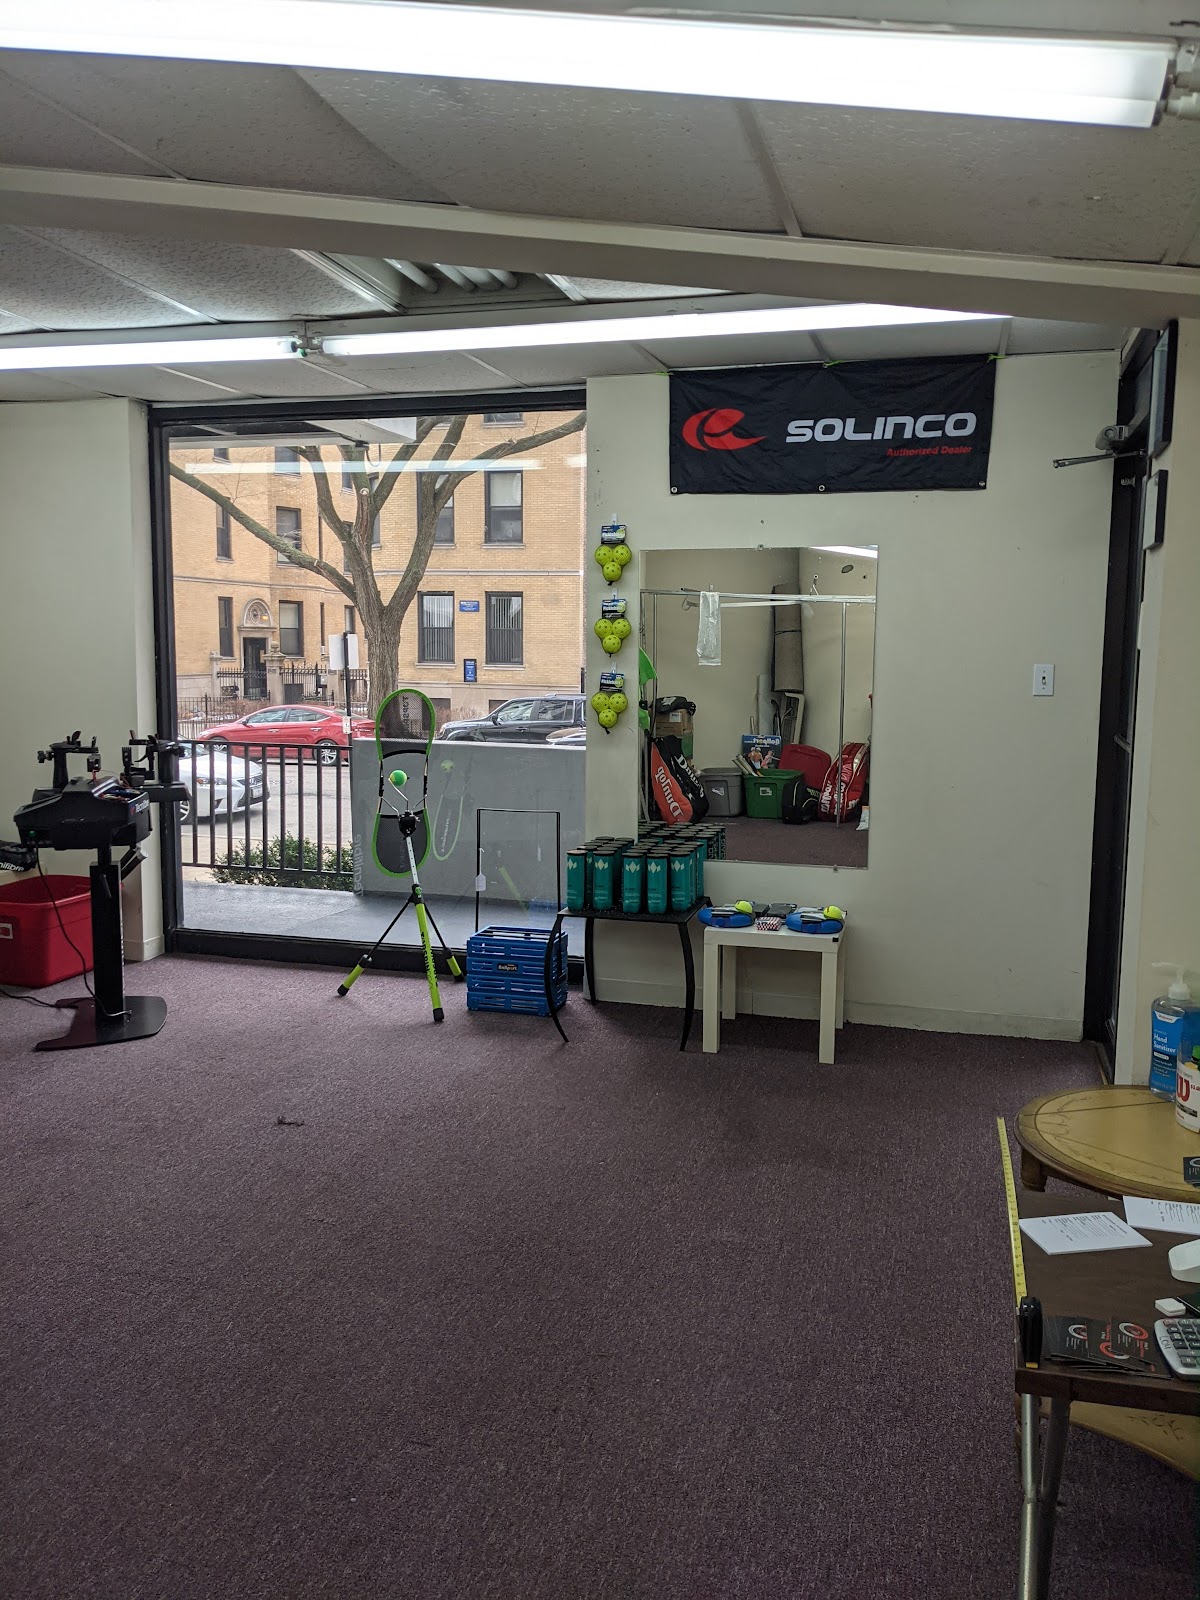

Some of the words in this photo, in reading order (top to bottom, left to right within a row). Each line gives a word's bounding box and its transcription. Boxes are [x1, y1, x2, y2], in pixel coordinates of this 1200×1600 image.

[785, 412, 977, 443] SOLINCO
[886, 446, 938, 457] Authorized
[941, 444, 973, 455] Dealer
[1153, 1033, 1168, 1043] Hand
[1153, 1040, 1176, 1053] Sanitizer
